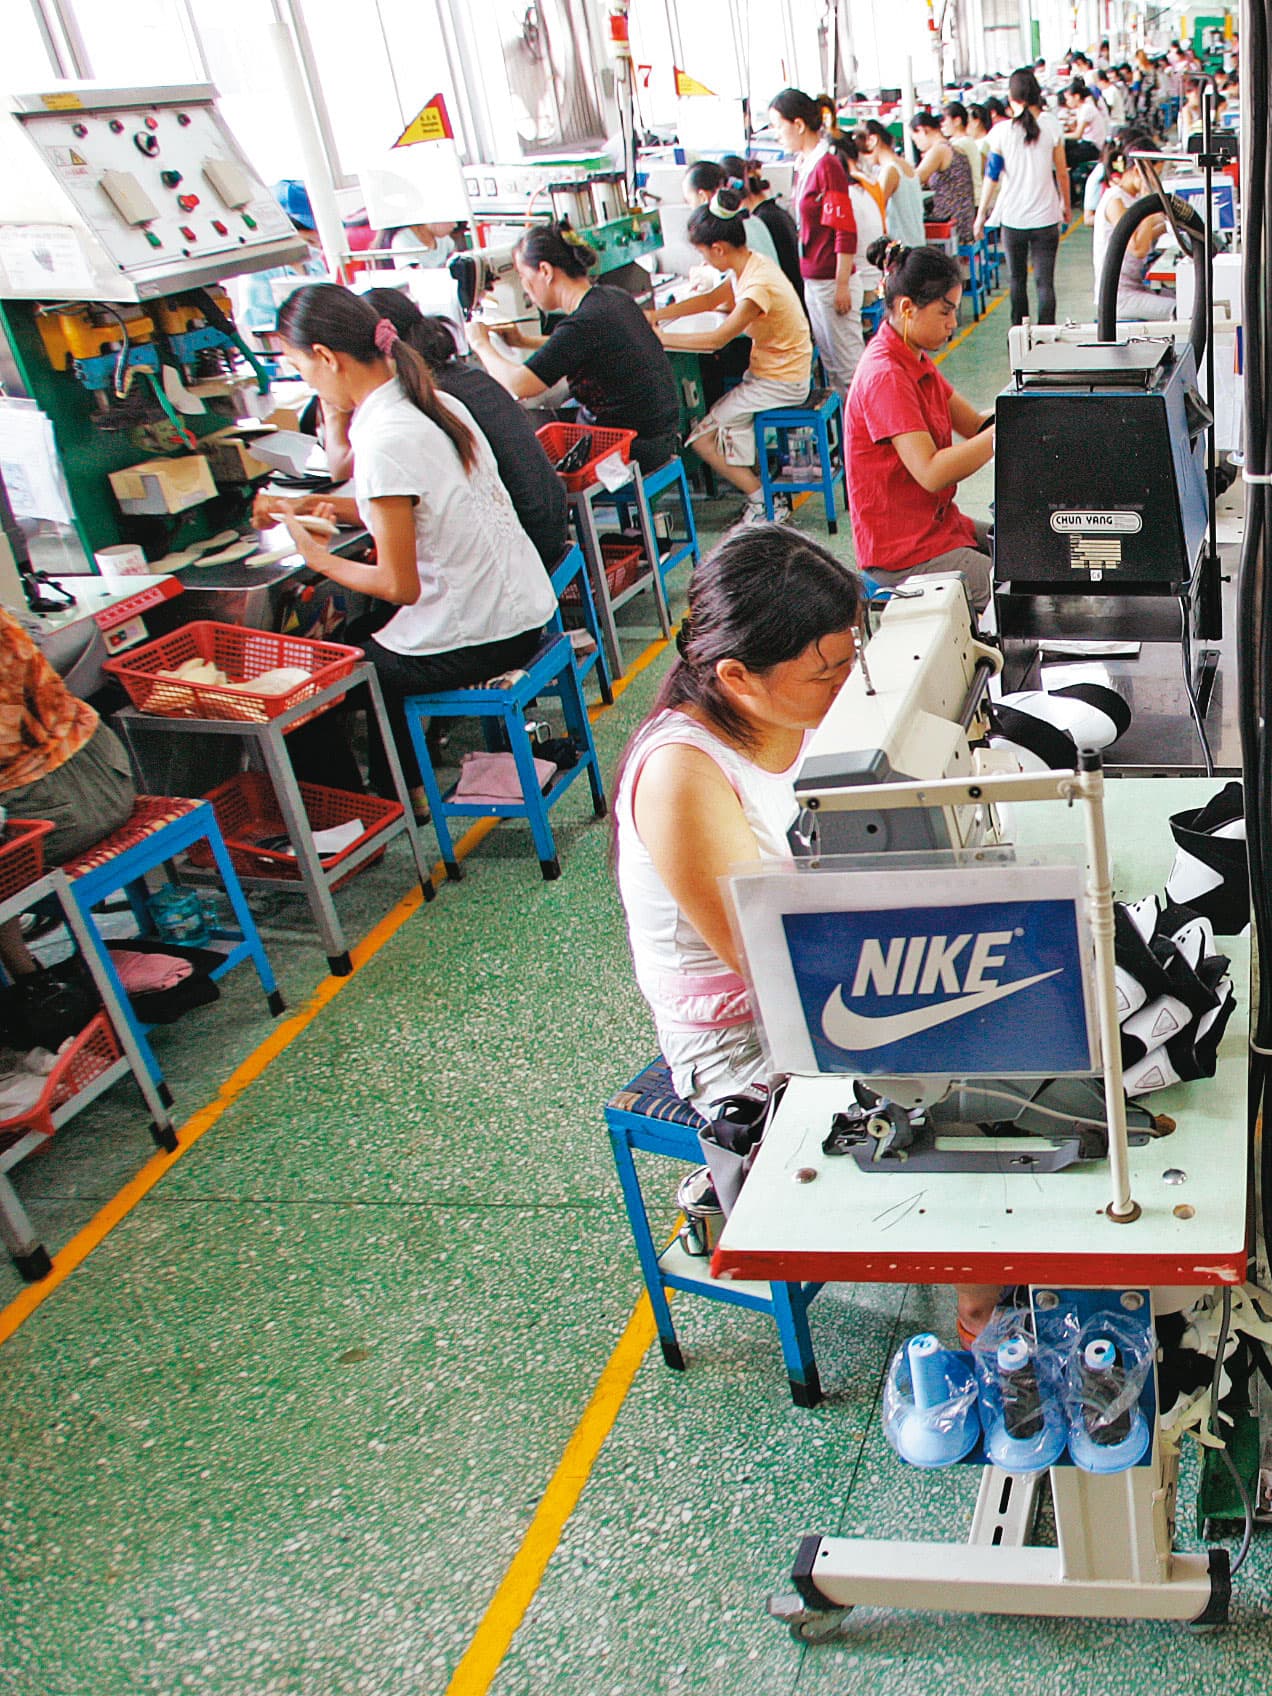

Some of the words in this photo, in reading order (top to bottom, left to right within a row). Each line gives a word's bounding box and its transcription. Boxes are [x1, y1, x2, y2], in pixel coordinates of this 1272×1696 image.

[638, 64, 652, 88] 7
[1056, 515, 1082, 525] CHUN
[1086, 515, 1113, 525] YANG
[851, 929, 1015, 997] NIKE
